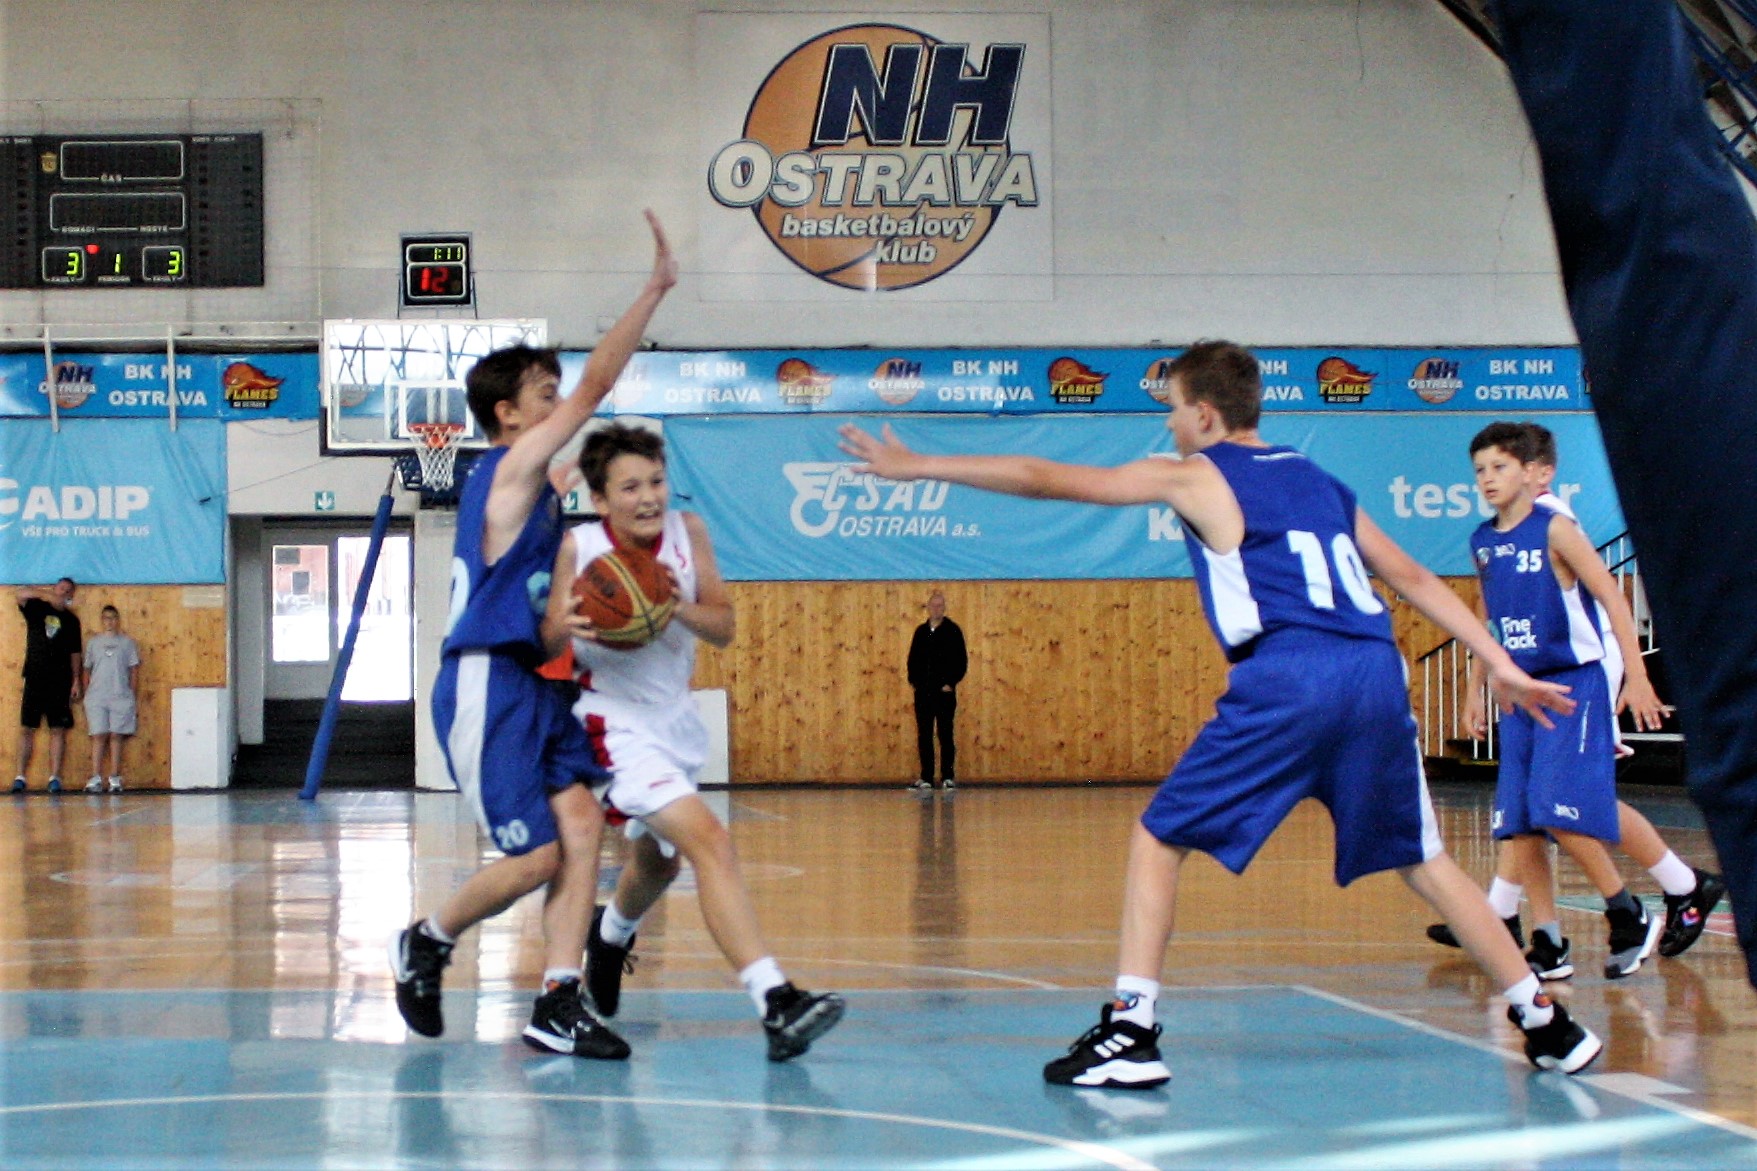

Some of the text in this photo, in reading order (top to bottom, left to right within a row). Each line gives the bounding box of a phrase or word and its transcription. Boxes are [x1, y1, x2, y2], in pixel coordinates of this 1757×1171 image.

[809, 42, 1027, 146] NH
[708, 138, 1040, 208] OSTRAVA
[781, 212, 975, 242] basketbalový
[66, 252, 80, 275] 3
[114, 253, 122, 274] 1
[167, 251, 181, 275] 3
[873, 240, 938, 264] klub
[421, 267, 449, 294] 12
[124, 364, 155, 379] BK
[679, 361, 747, 377] BK NH
[952, 359, 1020, 375] BK NH
[1489, 359, 1554, 375] BK NH
[38, 380, 97, 394] OTRAVA
[664, 387, 763, 403] OSTRAVA
[937, 385, 1035, 402] OSTRAVA
[1475, 385, 1570, 400] OSTRAVA
[73, 526, 111, 537] TRUCK
[838, 515, 983, 538] OSTRAVA a.s.
[1286, 530, 1384, 615] 10
[1516, 549, 1543, 574] 35
[495, 819, 530, 849] 20
